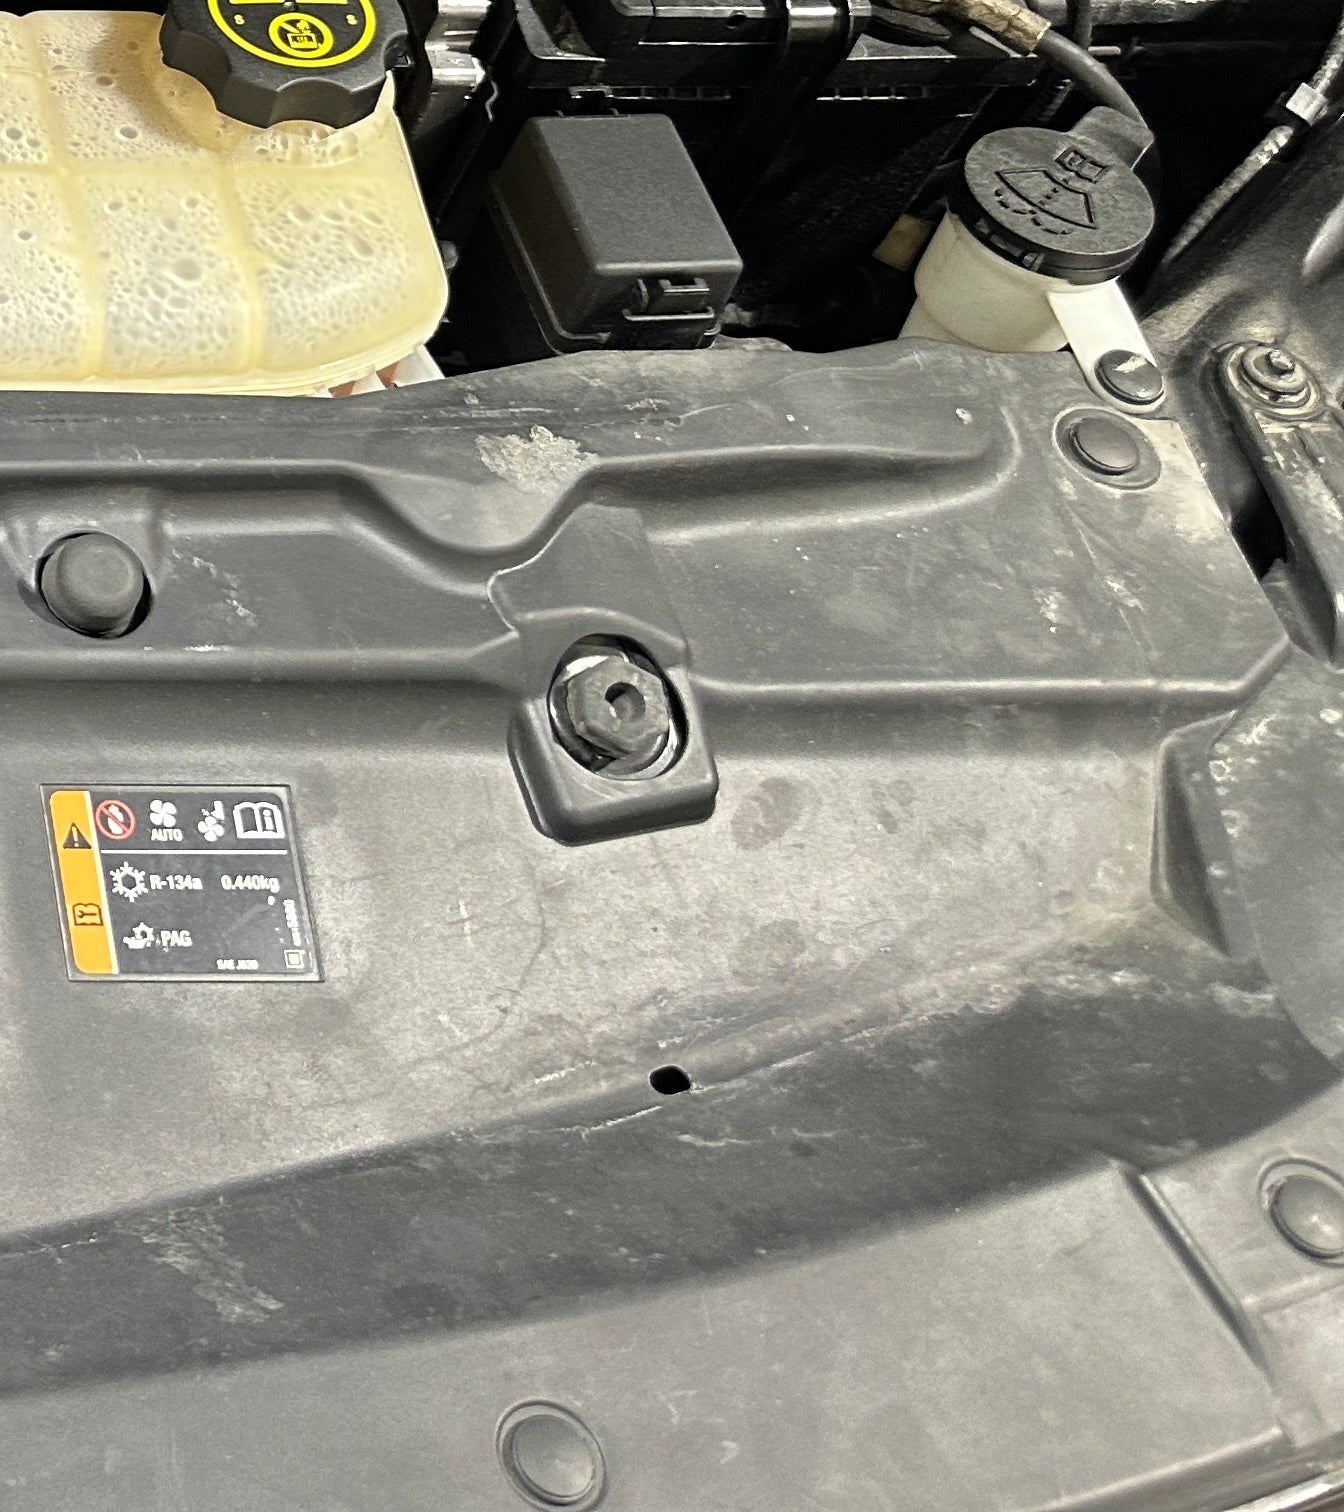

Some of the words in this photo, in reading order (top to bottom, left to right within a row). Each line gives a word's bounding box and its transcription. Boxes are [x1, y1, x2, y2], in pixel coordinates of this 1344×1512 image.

[150, 828, 183, 841] AUTO
[150, 874, 203, 890] R-134a
[221, 874, 280, 893] 0.440kg
[161, 929, 192, 946] PAG
